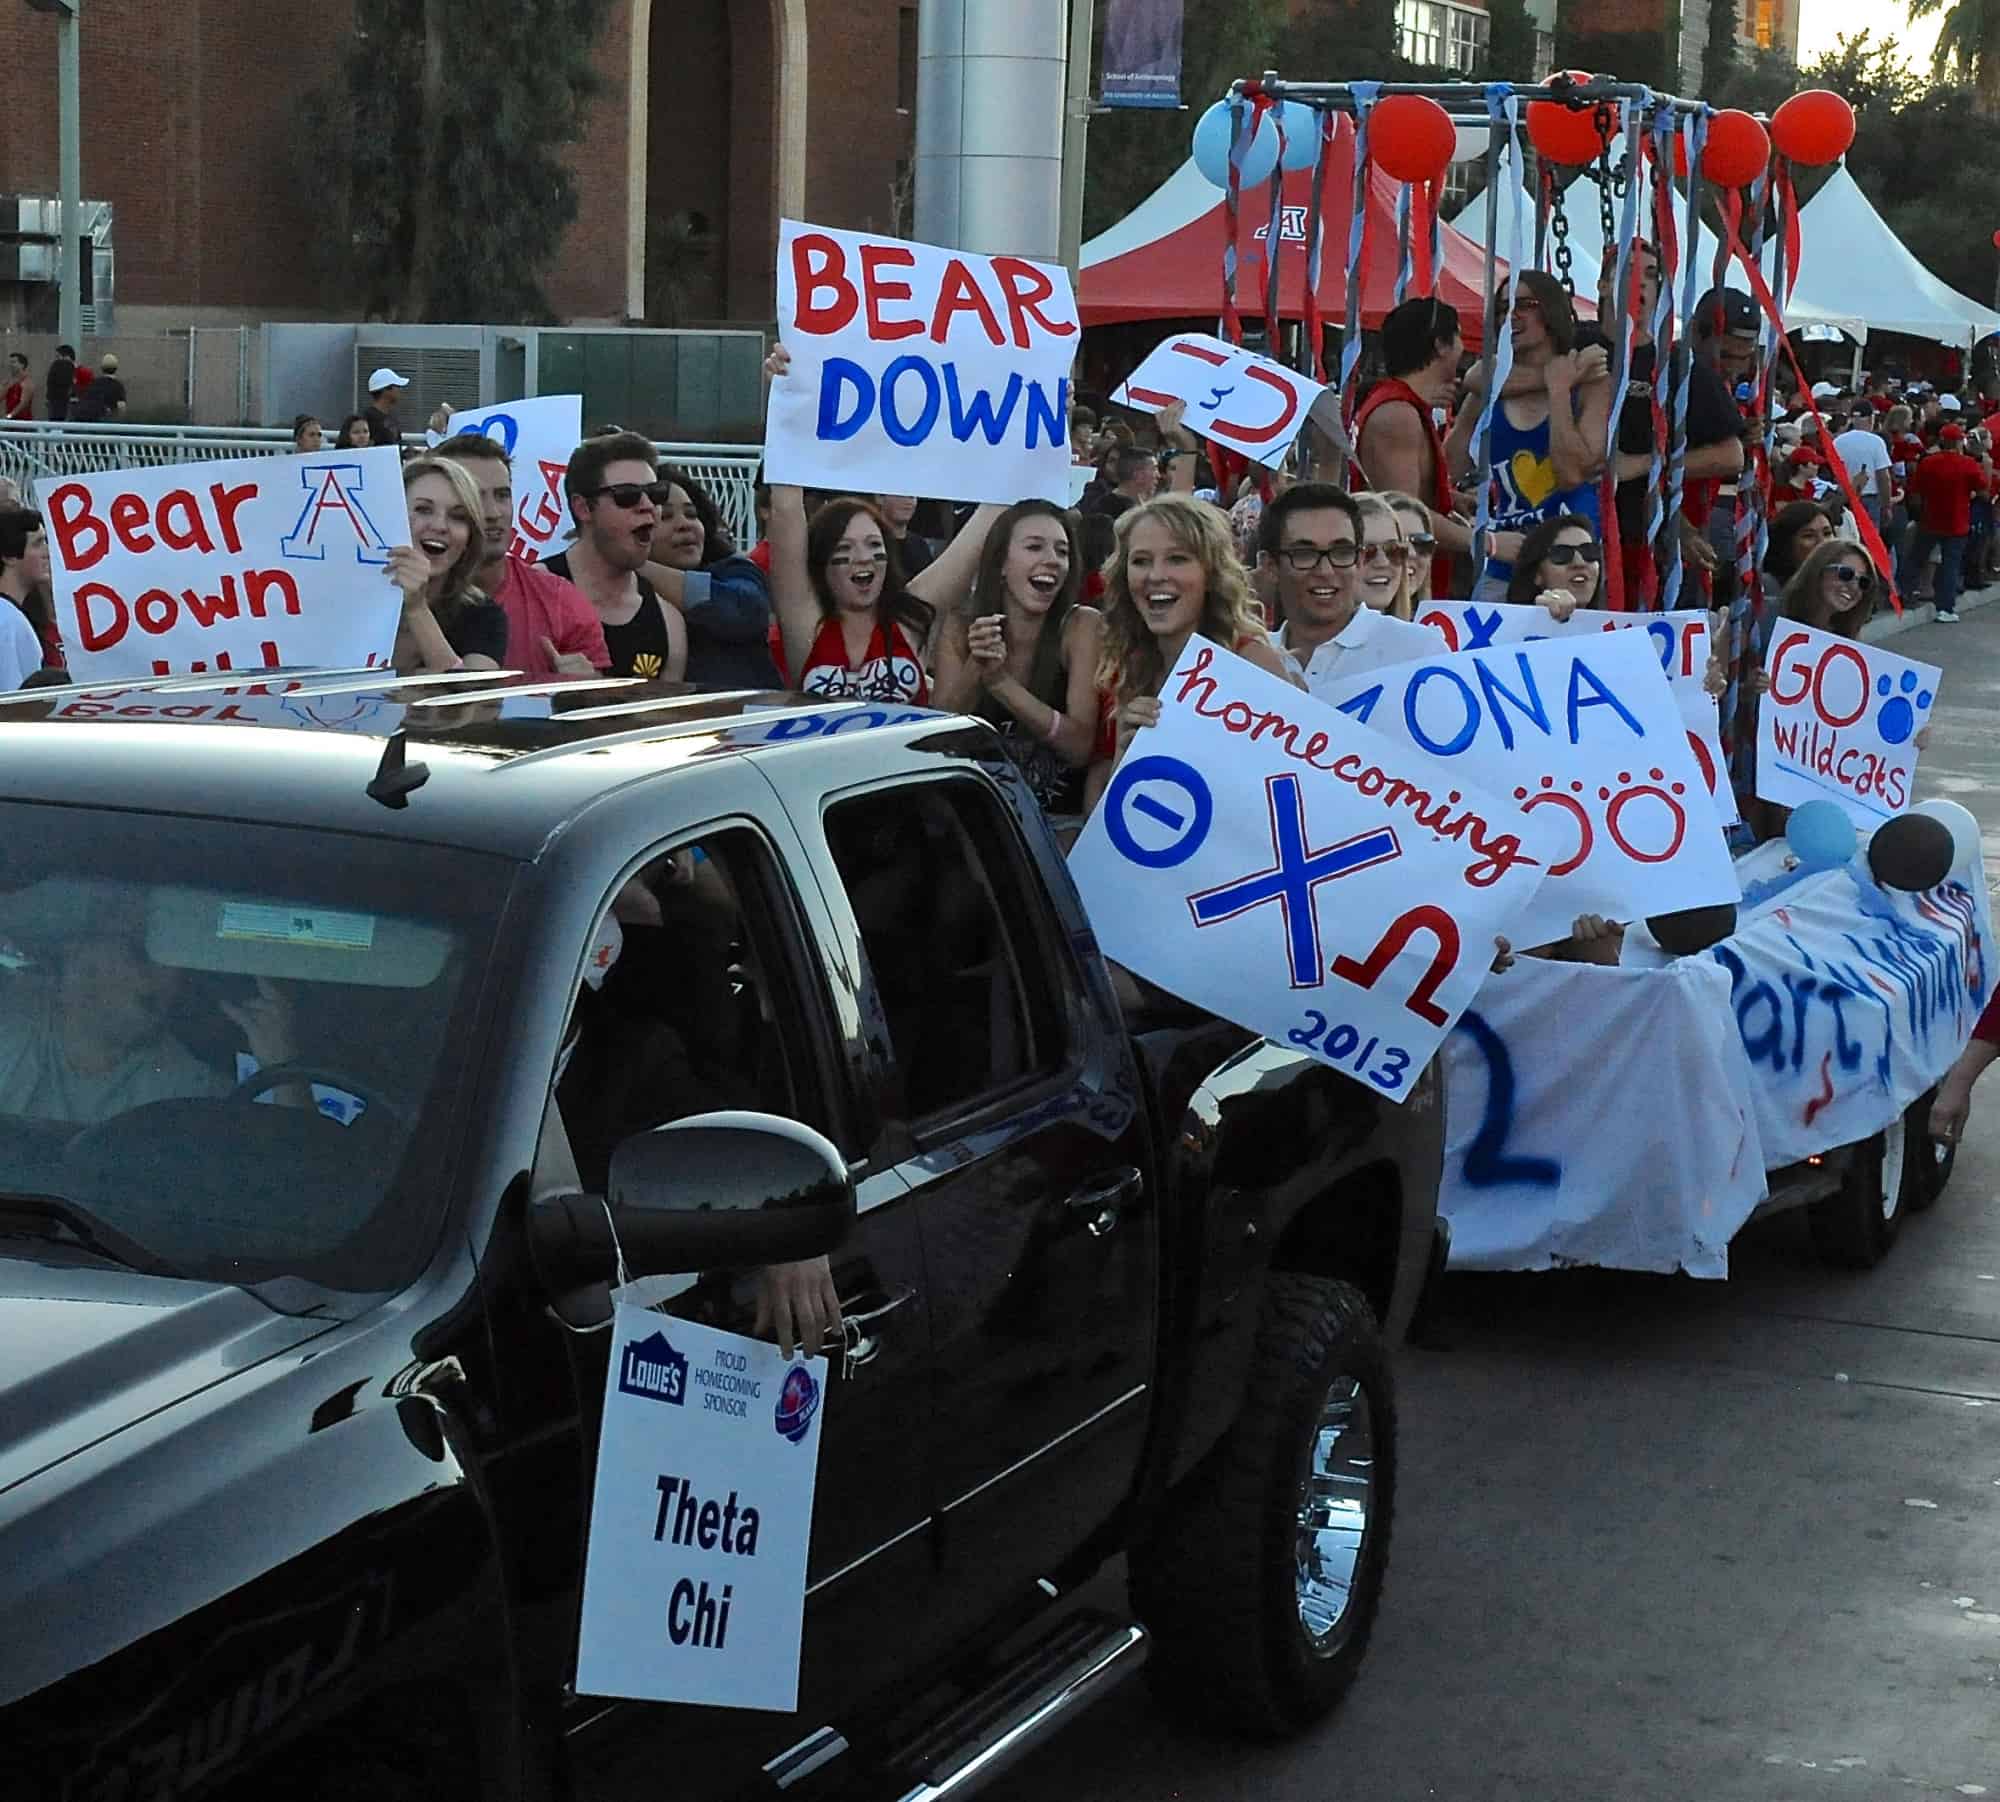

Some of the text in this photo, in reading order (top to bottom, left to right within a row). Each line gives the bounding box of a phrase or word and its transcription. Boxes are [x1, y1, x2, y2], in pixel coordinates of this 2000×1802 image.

[792, 234, 1077, 349] BEAR
[816, 355, 1067, 449] DOWN
[47, 483, 259, 572] Bear
[73, 569, 302, 652] Down
[1769, 632, 1870, 728] GO
[1177, 647, 1541, 887] homecoming
[1287, 1008, 1412, 1090] 2013
[694, 1366, 762, 1399] HOMECOMING
[714, 1348, 748, 1373] PROUD
[702, 1391, 748, 1419] SPONSOR
[654, 1474, 761, 1557] Theta
[668, 1577, 734, 1649] Chi
